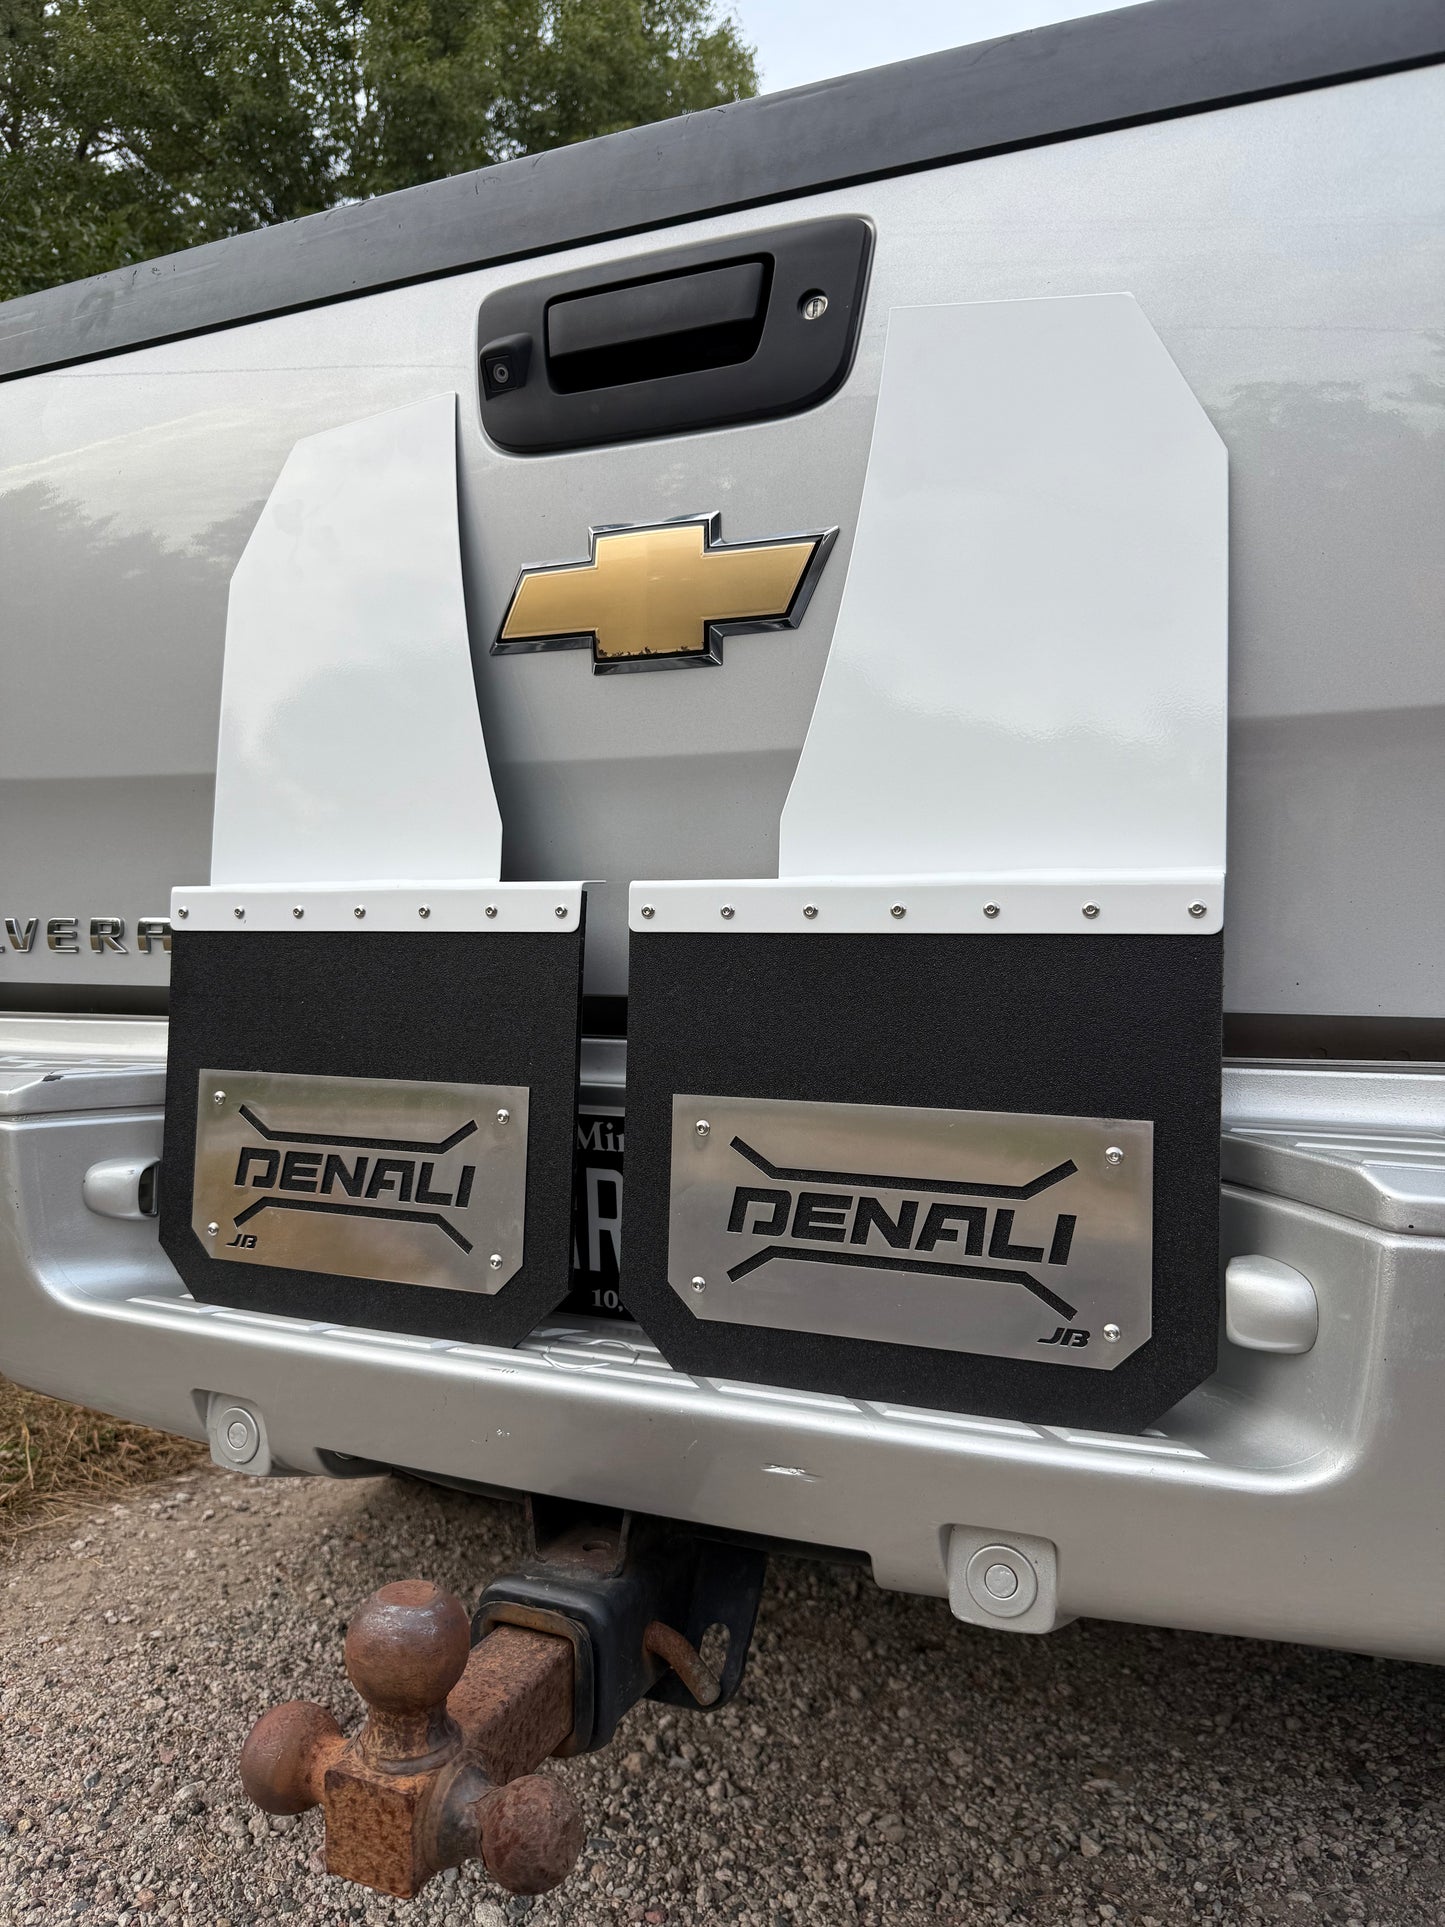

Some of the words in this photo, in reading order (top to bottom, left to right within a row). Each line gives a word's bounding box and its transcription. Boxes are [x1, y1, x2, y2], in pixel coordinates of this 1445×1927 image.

[0, 917, 172, 954] VERA
[234, 1146, 476, 1209] DENALI
[225, 1233, 258, 1249] JB
[726, 1186, 1077, 1266] DENALI
[1036, 1327, 1090, 1348] JB
